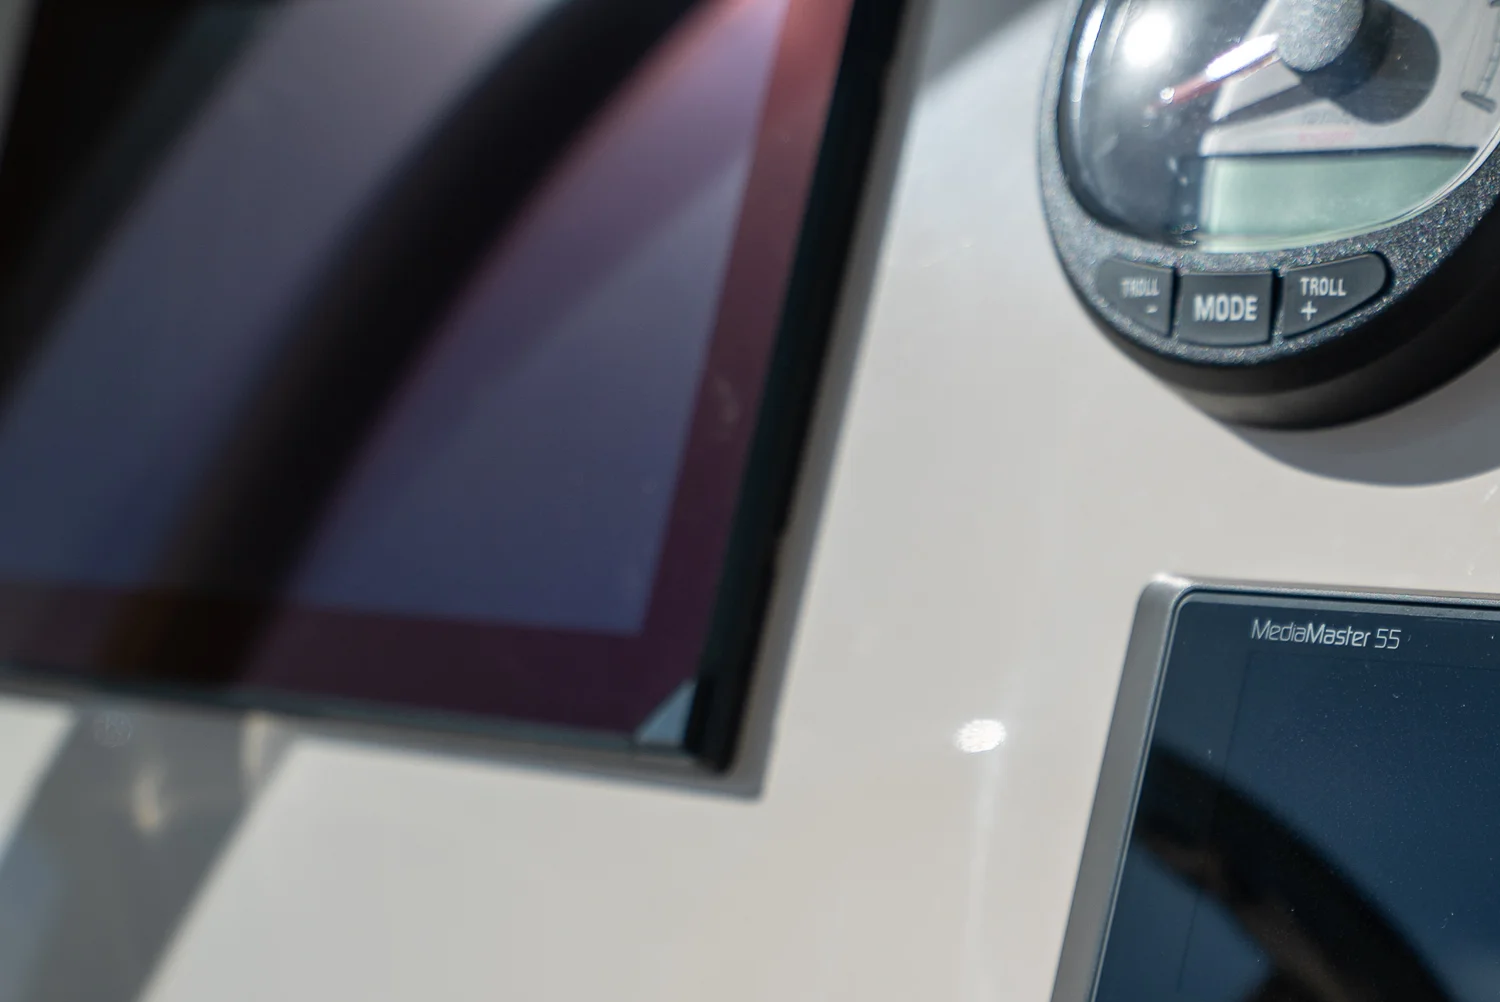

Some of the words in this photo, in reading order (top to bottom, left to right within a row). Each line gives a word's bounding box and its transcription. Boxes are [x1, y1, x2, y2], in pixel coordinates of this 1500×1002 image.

[1121, 277, 1160, 297] TROLL
[1300, 277, 1347, 297] TROLL
[1194, 294, 1259, 322] MODE
[1251, 618, 1371, 649] MediaMaster
[1374, 628, 1402, 650] 55
